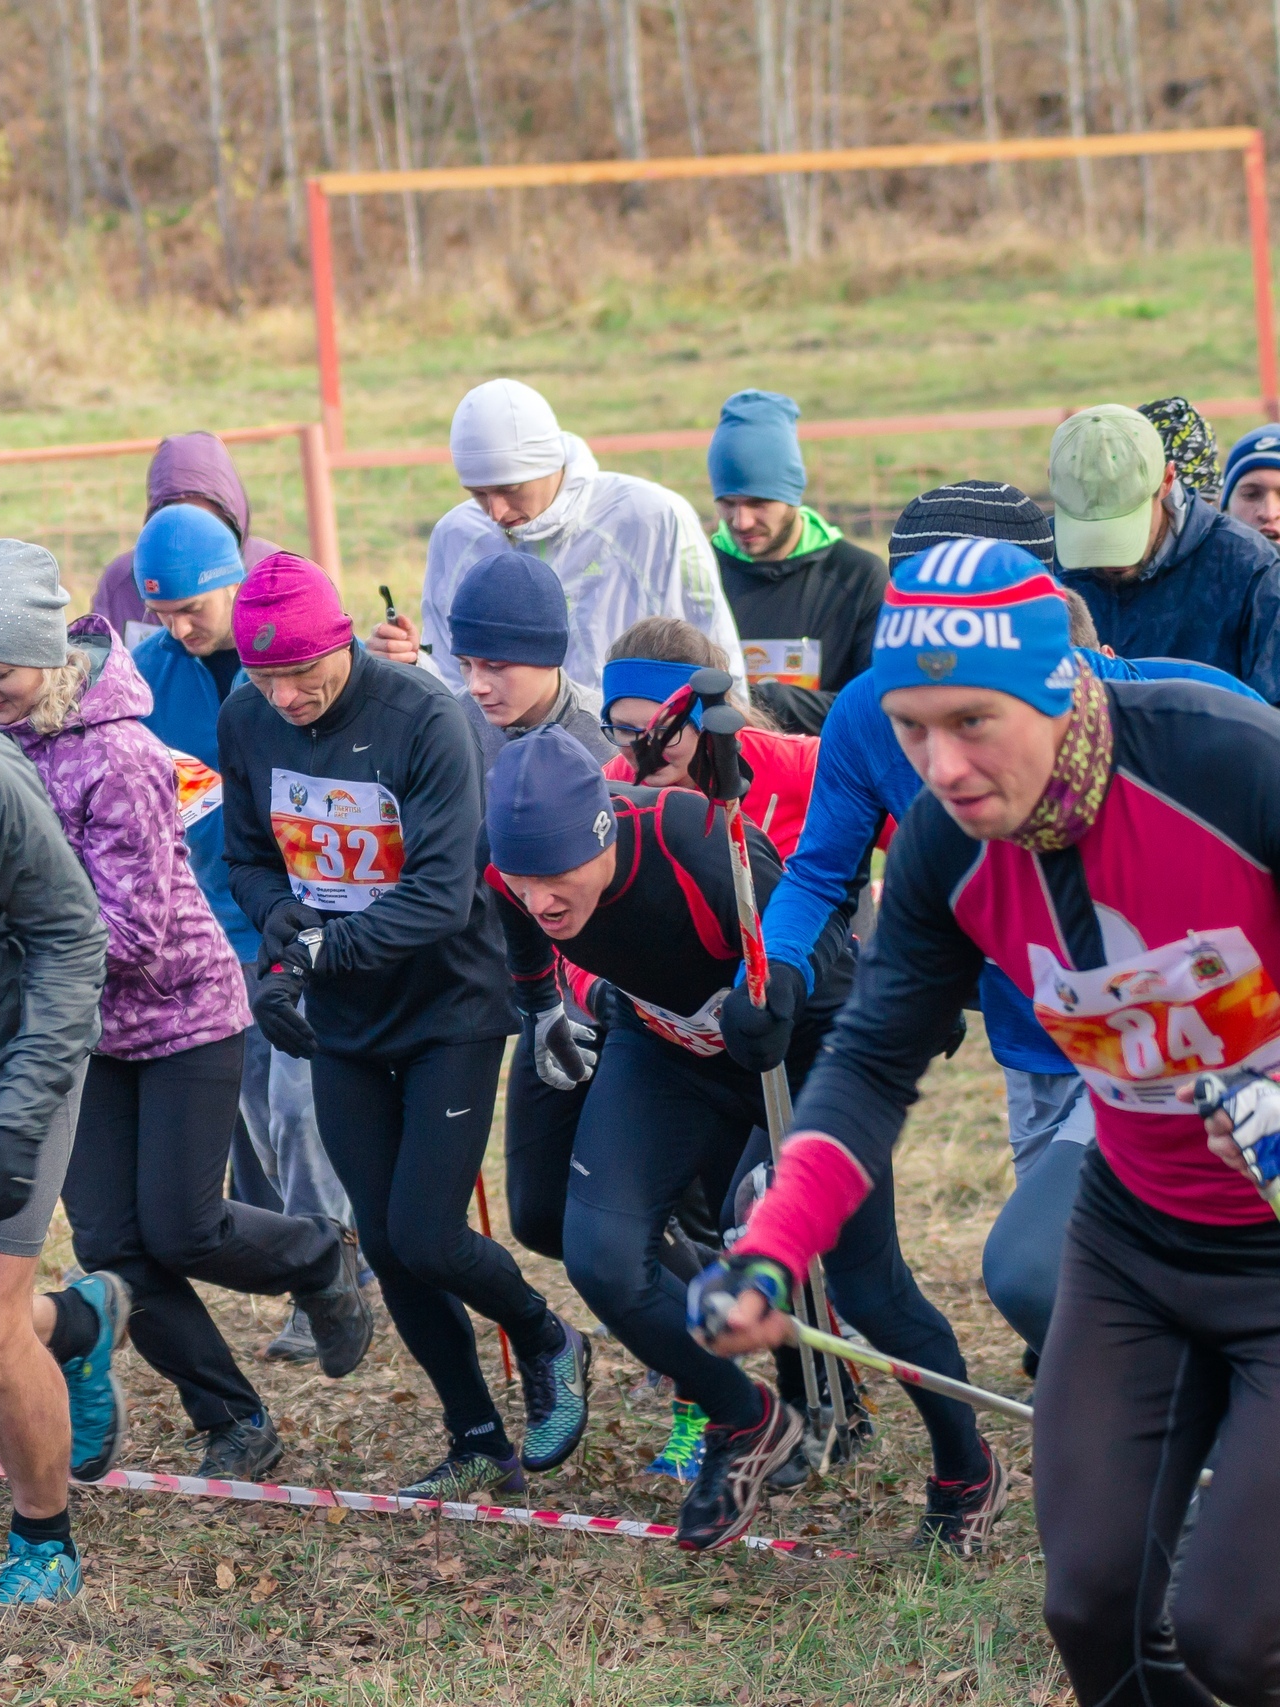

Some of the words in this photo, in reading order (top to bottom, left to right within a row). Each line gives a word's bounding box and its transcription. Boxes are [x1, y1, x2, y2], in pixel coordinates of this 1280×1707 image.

[874, 607, 1021, 650] LUKOIL
[311, 824, 385, 881] 32
[1106, 1006, 1225, 1079] 84
